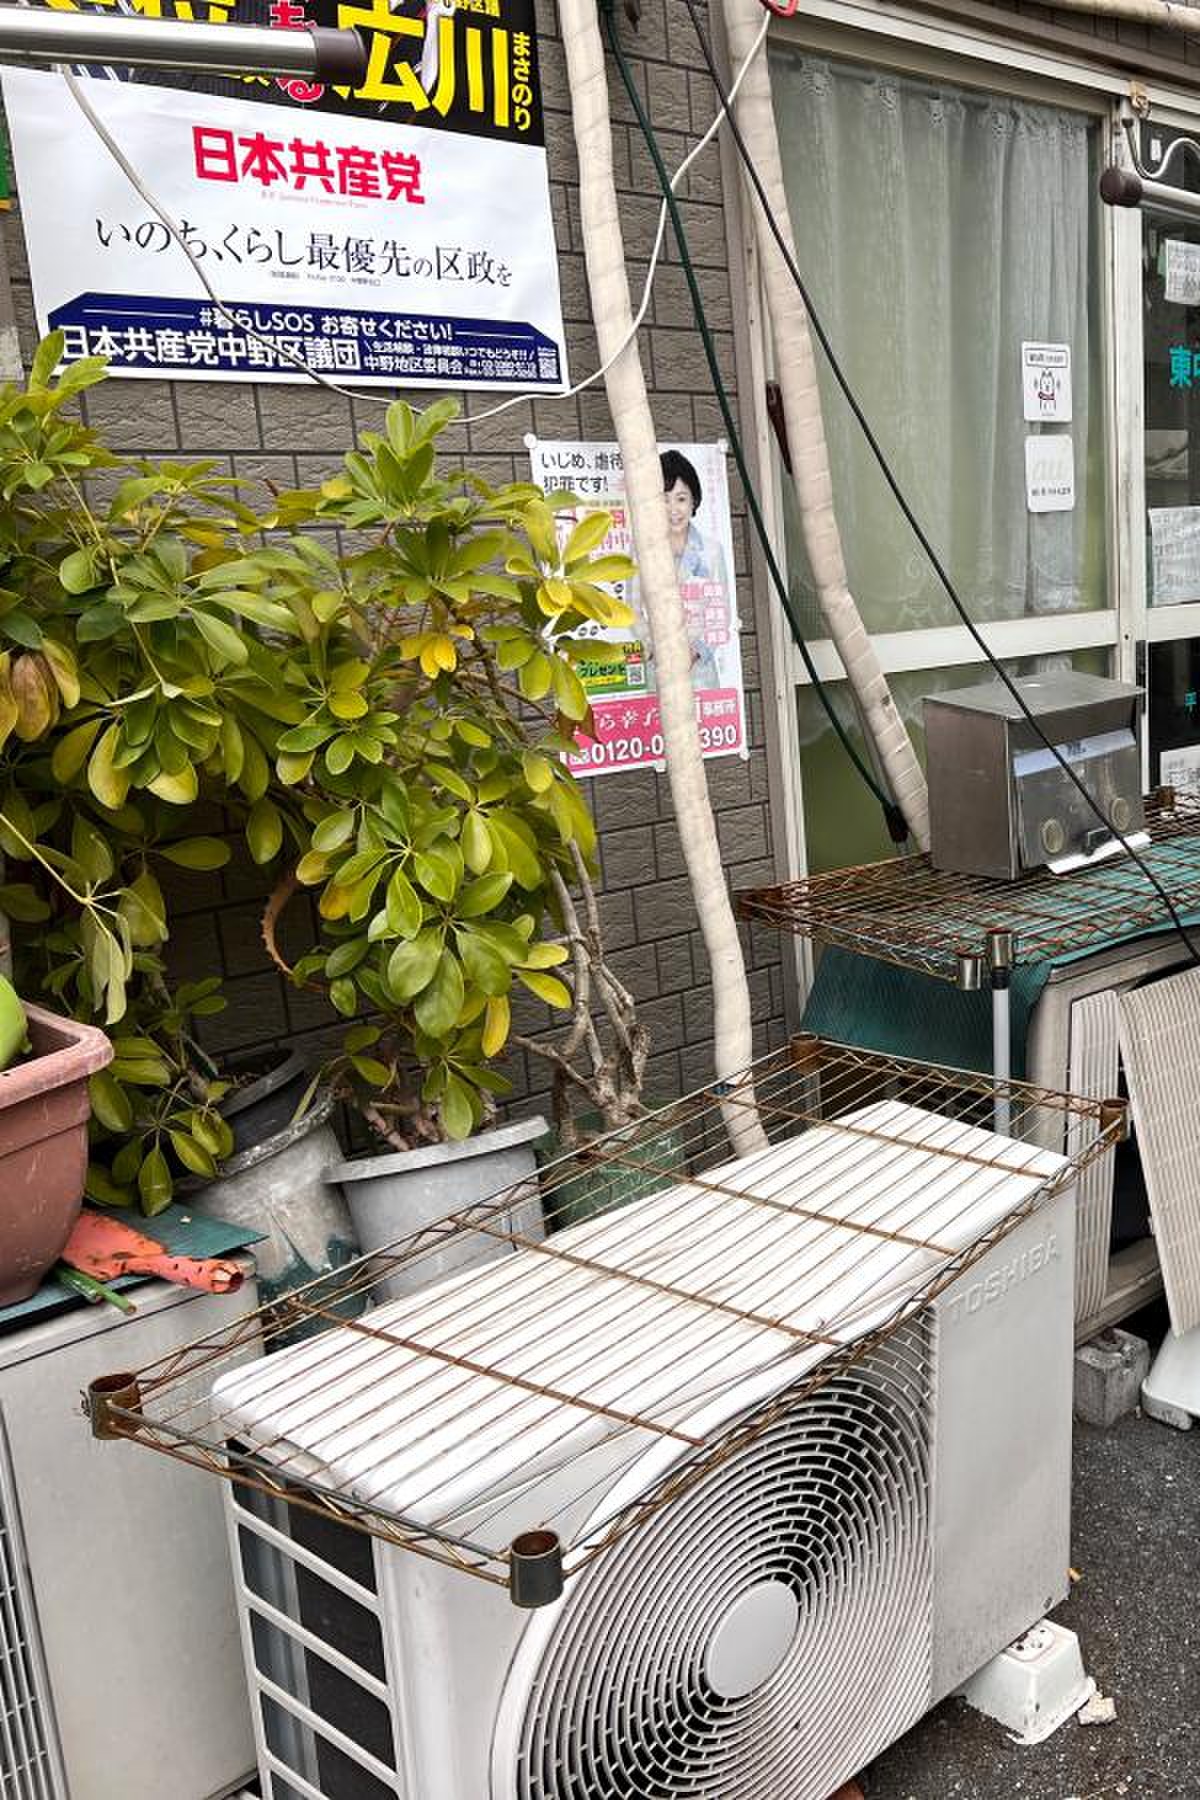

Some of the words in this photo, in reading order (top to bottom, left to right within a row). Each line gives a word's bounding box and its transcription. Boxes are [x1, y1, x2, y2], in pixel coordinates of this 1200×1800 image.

[511, 31, 533, 131] まさのり
[192, 125, 425, 205] 日本共産党
[95, 216, 513, 288] いのち、くらし最優先の区政を
[61, 325, 361, 371] 日本共産党中野区議団
